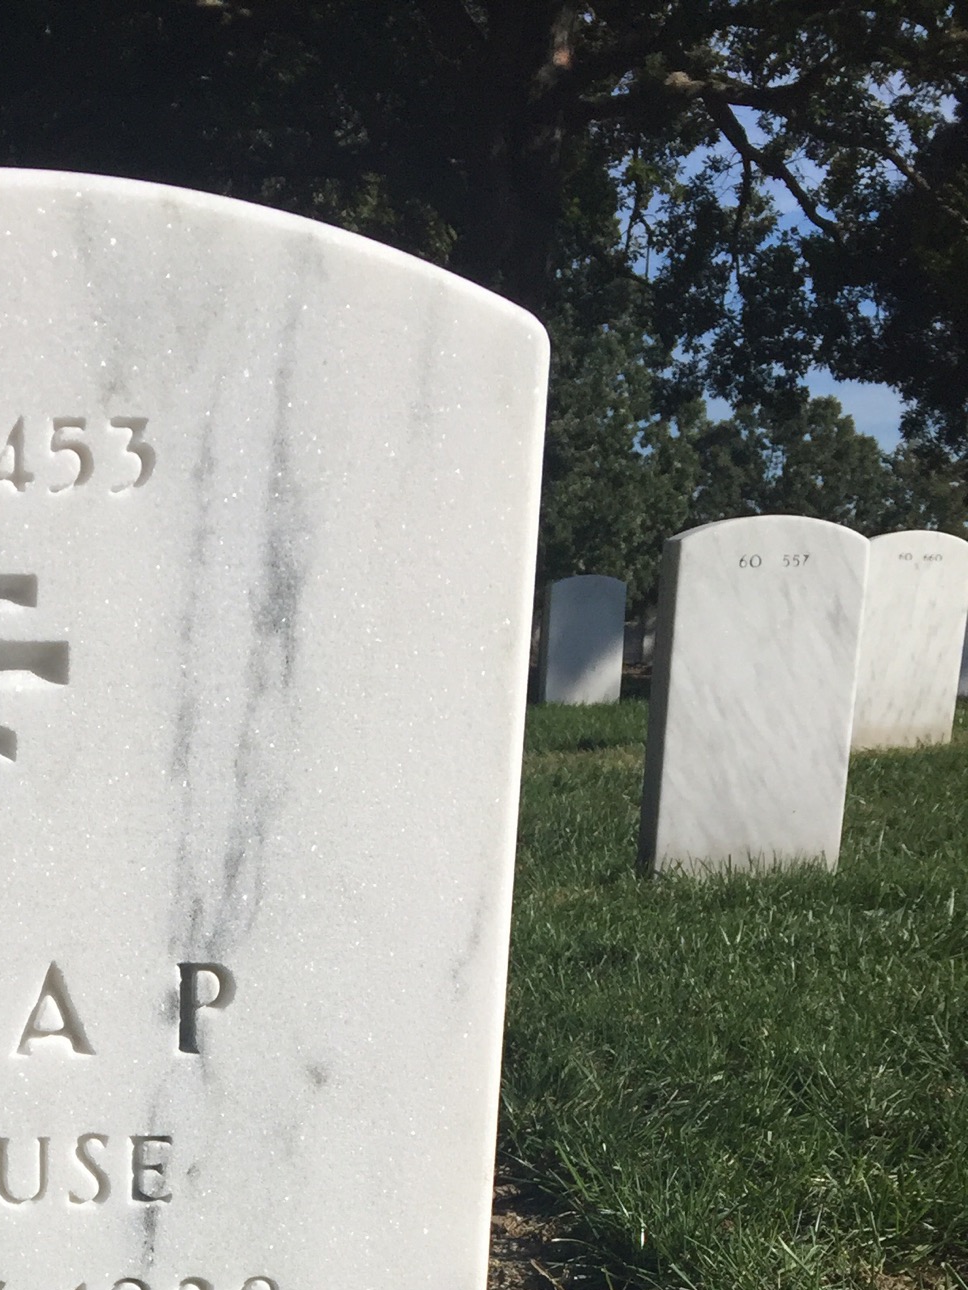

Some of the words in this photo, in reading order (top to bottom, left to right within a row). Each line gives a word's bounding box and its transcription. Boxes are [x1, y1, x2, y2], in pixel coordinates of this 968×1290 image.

[738, 553, 762, 568] 60
[782, 553, 810, 568] 557
[176, 961, 237, 1055] P
